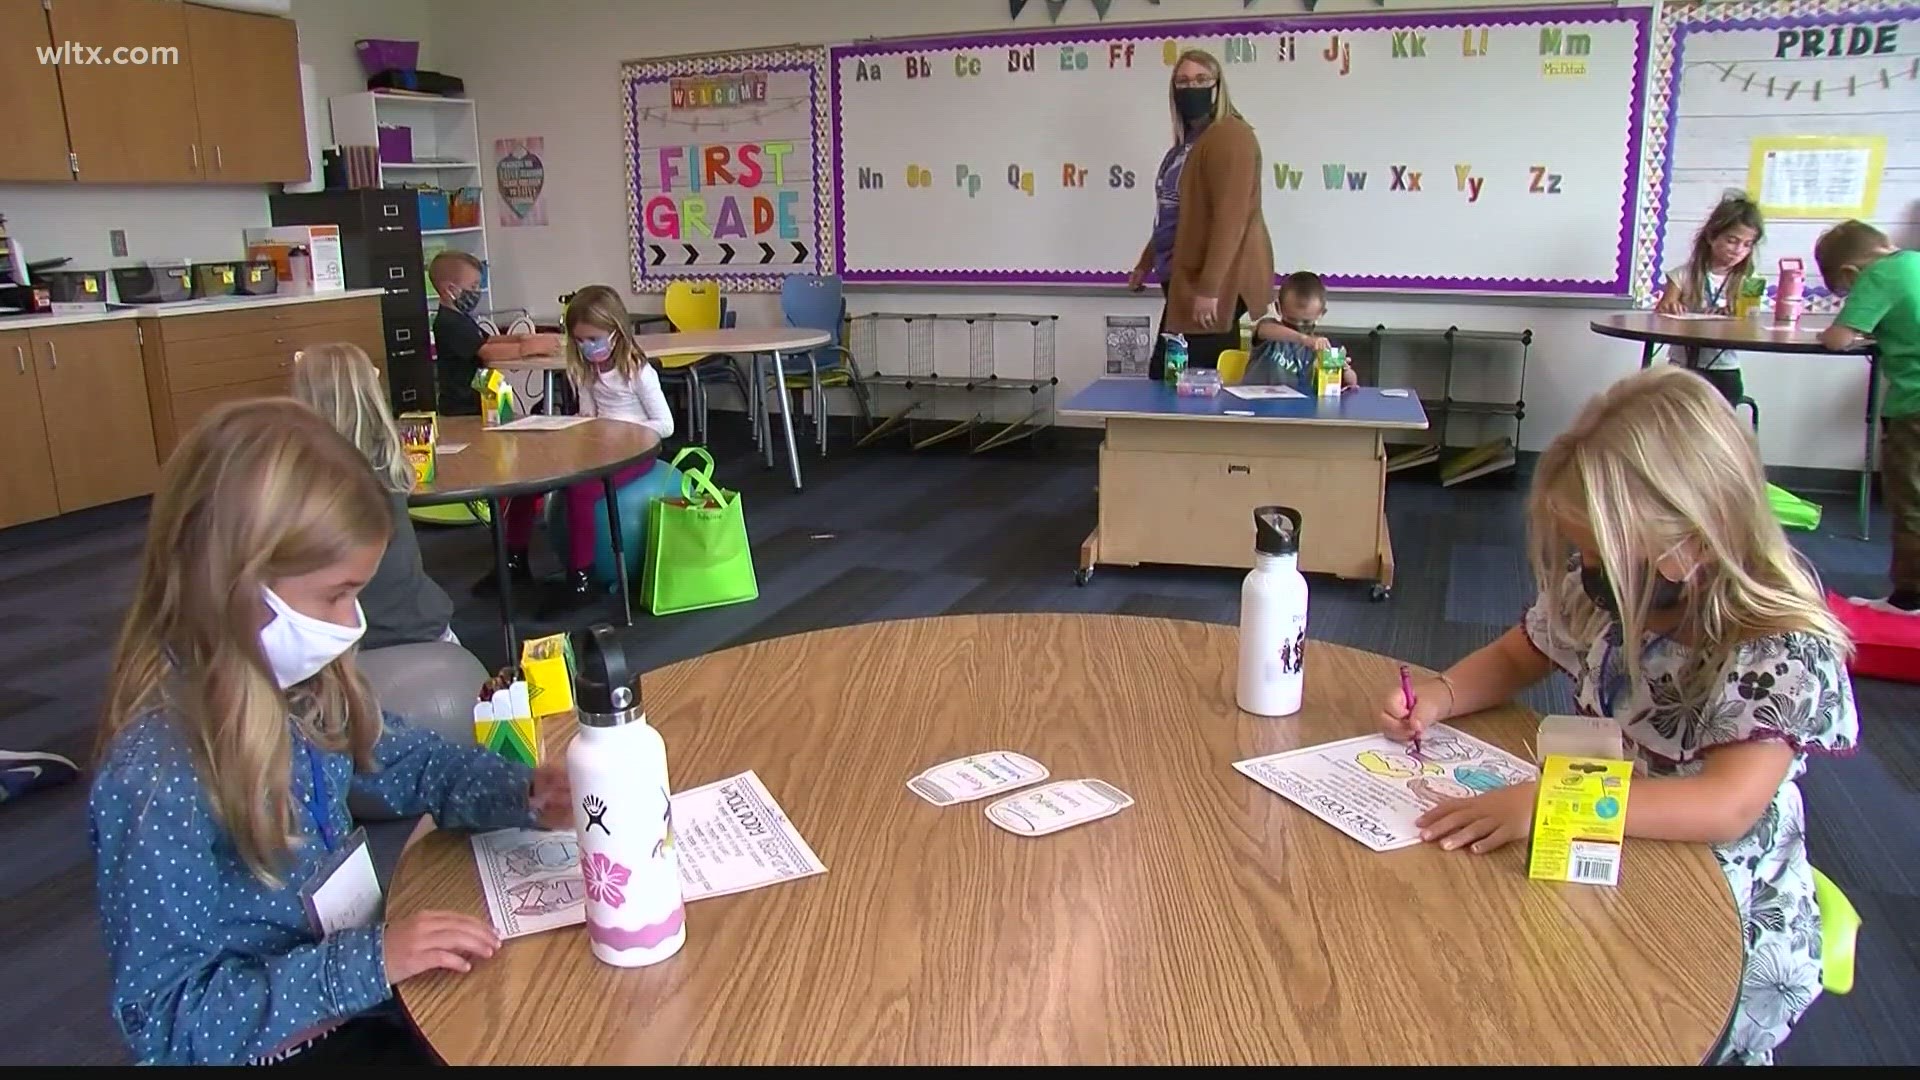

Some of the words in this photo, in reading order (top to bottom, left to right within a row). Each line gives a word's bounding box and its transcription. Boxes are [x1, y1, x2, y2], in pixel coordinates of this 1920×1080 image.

[856, 59, 882, 82] Aa
[906, 55, 932, 79] Bb
[955, 53, 982, 77] Cc
[1008, 49, 1035, 73] Dd
[1060, 46, 1089, 71] Ee
[1109, 43, 1135, 68] Ff
[1324, 36, 1350, 75] Jj
[1392, 31, 1427, 58] Kk
[1539, 28, 1591, 56] Mm
[1774, 24, 1900, 58] PRIDE
[673, 82, 766, 105] WELCOME
[659, 142, 794, 193] FIRST
[859, 167, 883, 190] Nn
[956, 164, 981, 198] Pp
[1008, 165, 1034, 196] Qq
[1063, 163, 1088, 188] Rr
[1109, 165, 1135, 189] Ss
[1273, 163, 1303, 190] Vv
[1322, 164, 1367, 191] Ww
[1389, 165, 1422, 191] Xx
[1455, 165, 1484, 202] Yy
[1529, 166, 1562, 193] Zz
[646, 190, 799, 240] GRADE
